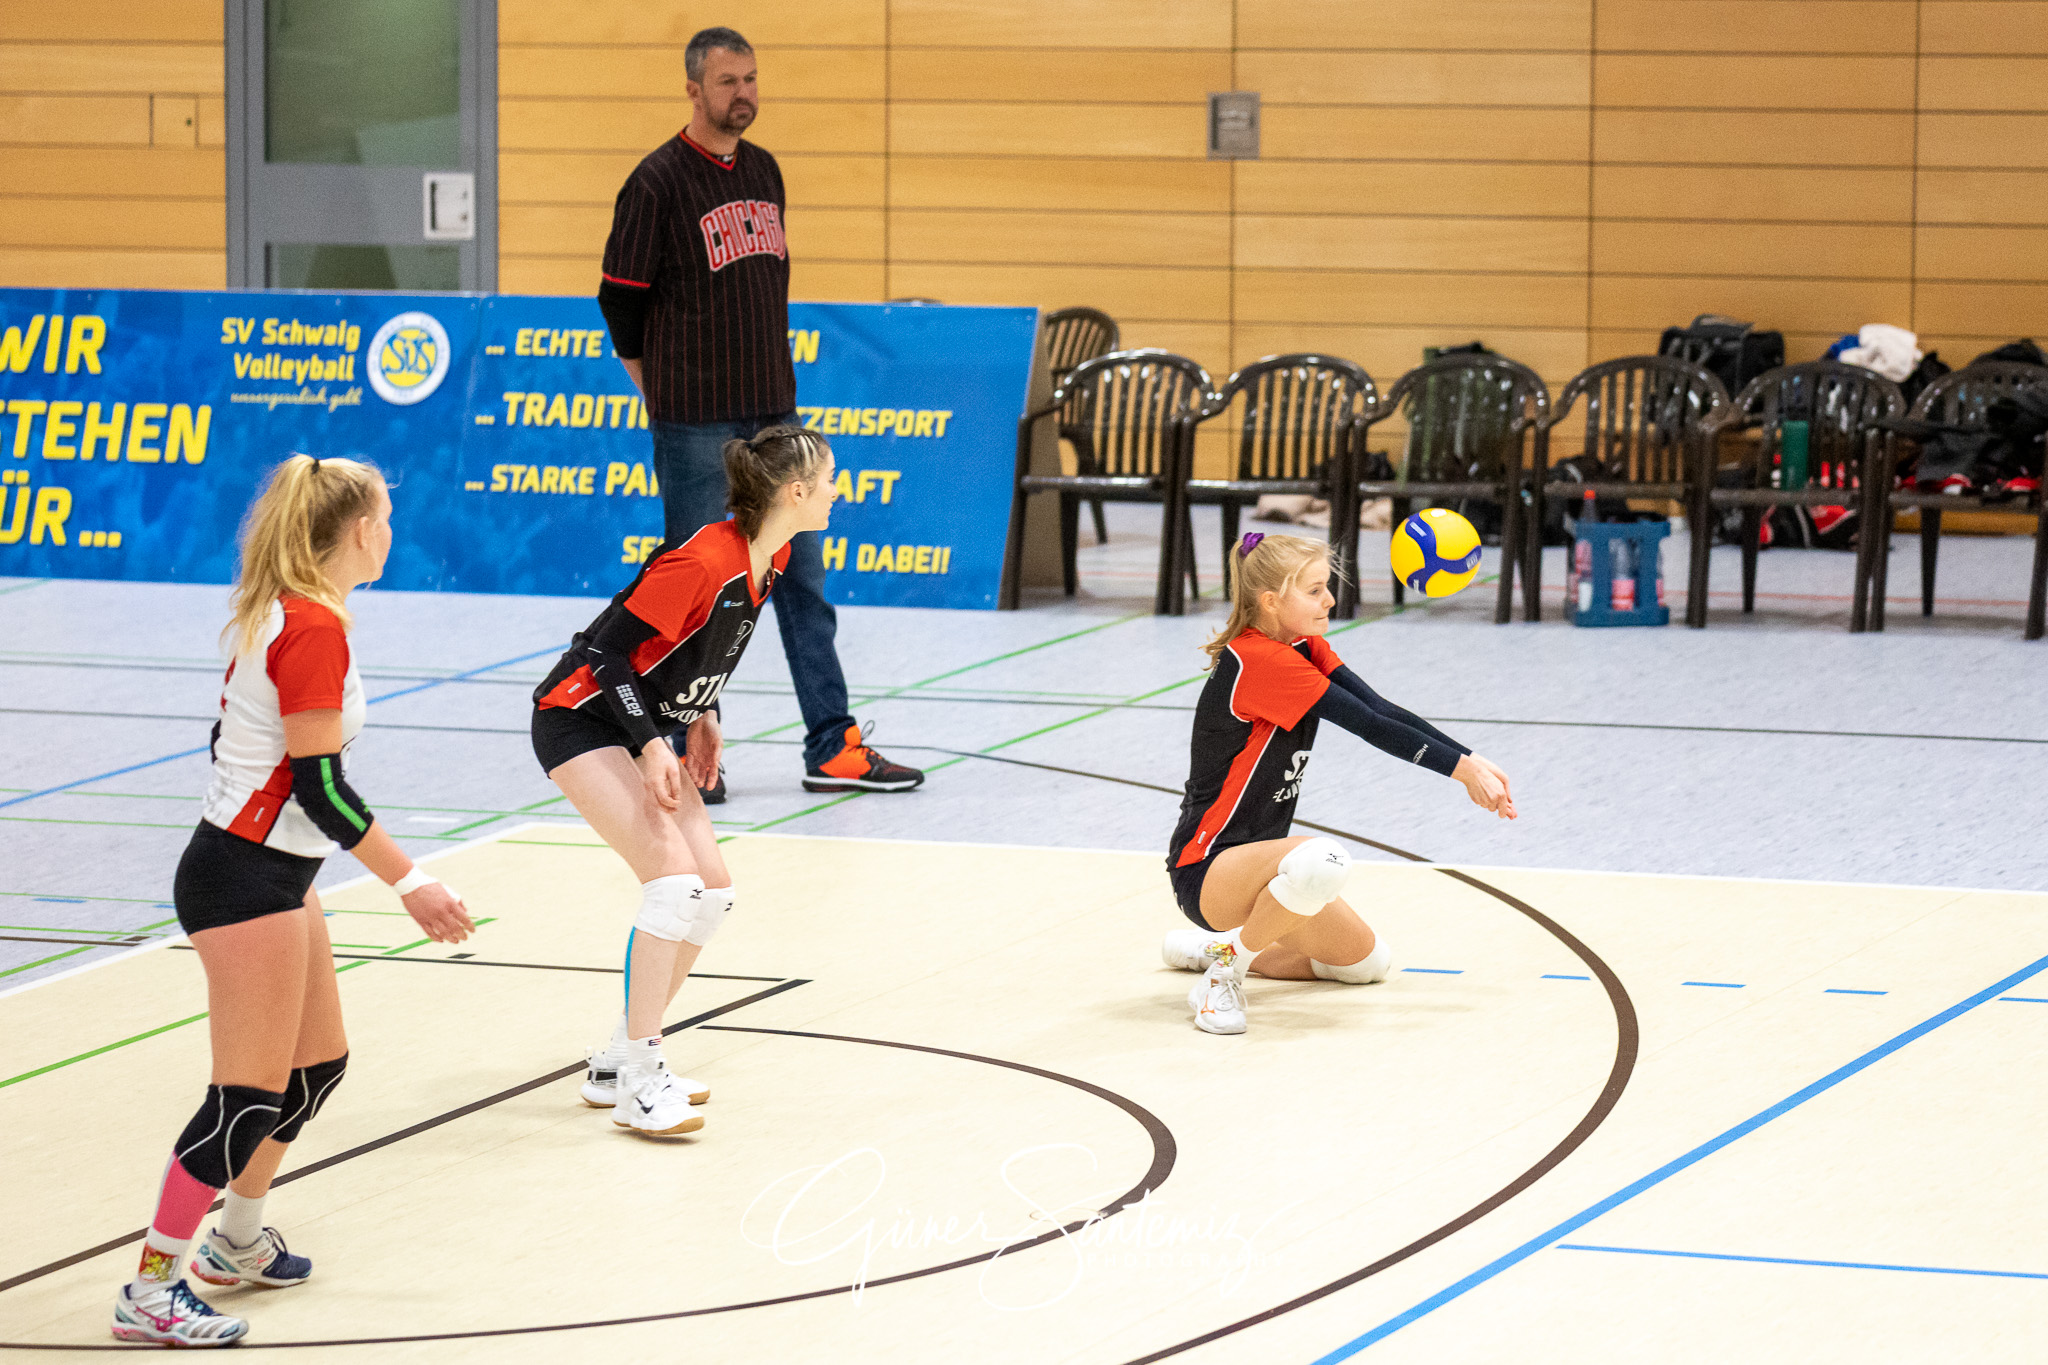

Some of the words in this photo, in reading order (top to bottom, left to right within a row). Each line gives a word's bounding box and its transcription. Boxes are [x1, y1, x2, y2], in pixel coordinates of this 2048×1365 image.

[0, 314, 106, 375] WIR
[220, 317, 255, 345] SV
[261, 318, 361, 353] Schwaig
[515, 328, 605, 358] ECHTE
[233, 352, 356, 387] Volleyball
[0, 399, 212, 465] TEHEN
[490, 463, 597, 495] STARKE
[833, 469, 902, 505] AFT
[0, 470, 72, 546] ÜR
